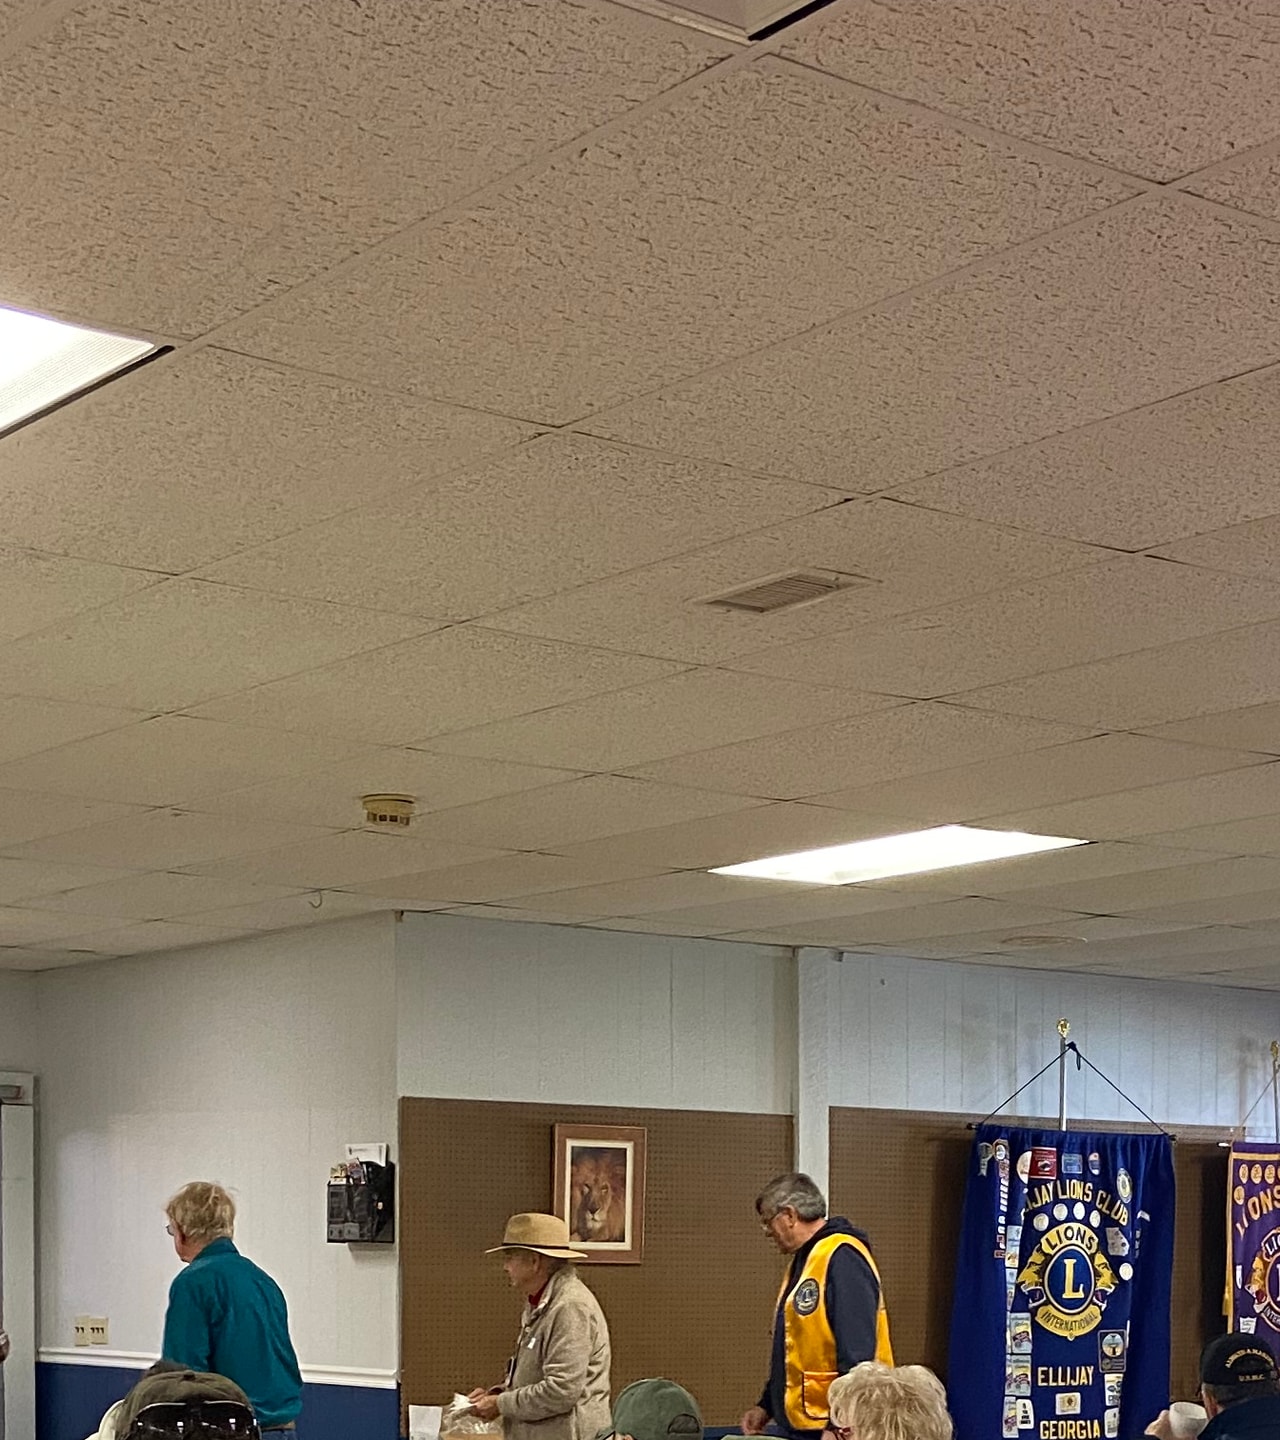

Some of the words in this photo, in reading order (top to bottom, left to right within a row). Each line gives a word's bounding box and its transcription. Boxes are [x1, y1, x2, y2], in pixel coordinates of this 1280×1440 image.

[1056, 1179, 1094, 1202] LIONS
[1095, 1190, 1129, 1226] CLUB
[1045, 1226, 1096, 1251] LIONS
[1062, 1259, 1085, 1299] L
[1040, 1310, 1099, 1333] INTERNATIONAL
[1037, 1365, 1095, 1387] ELLIJAY
[1040, 1419, 1101, 1440] GEORGIA
